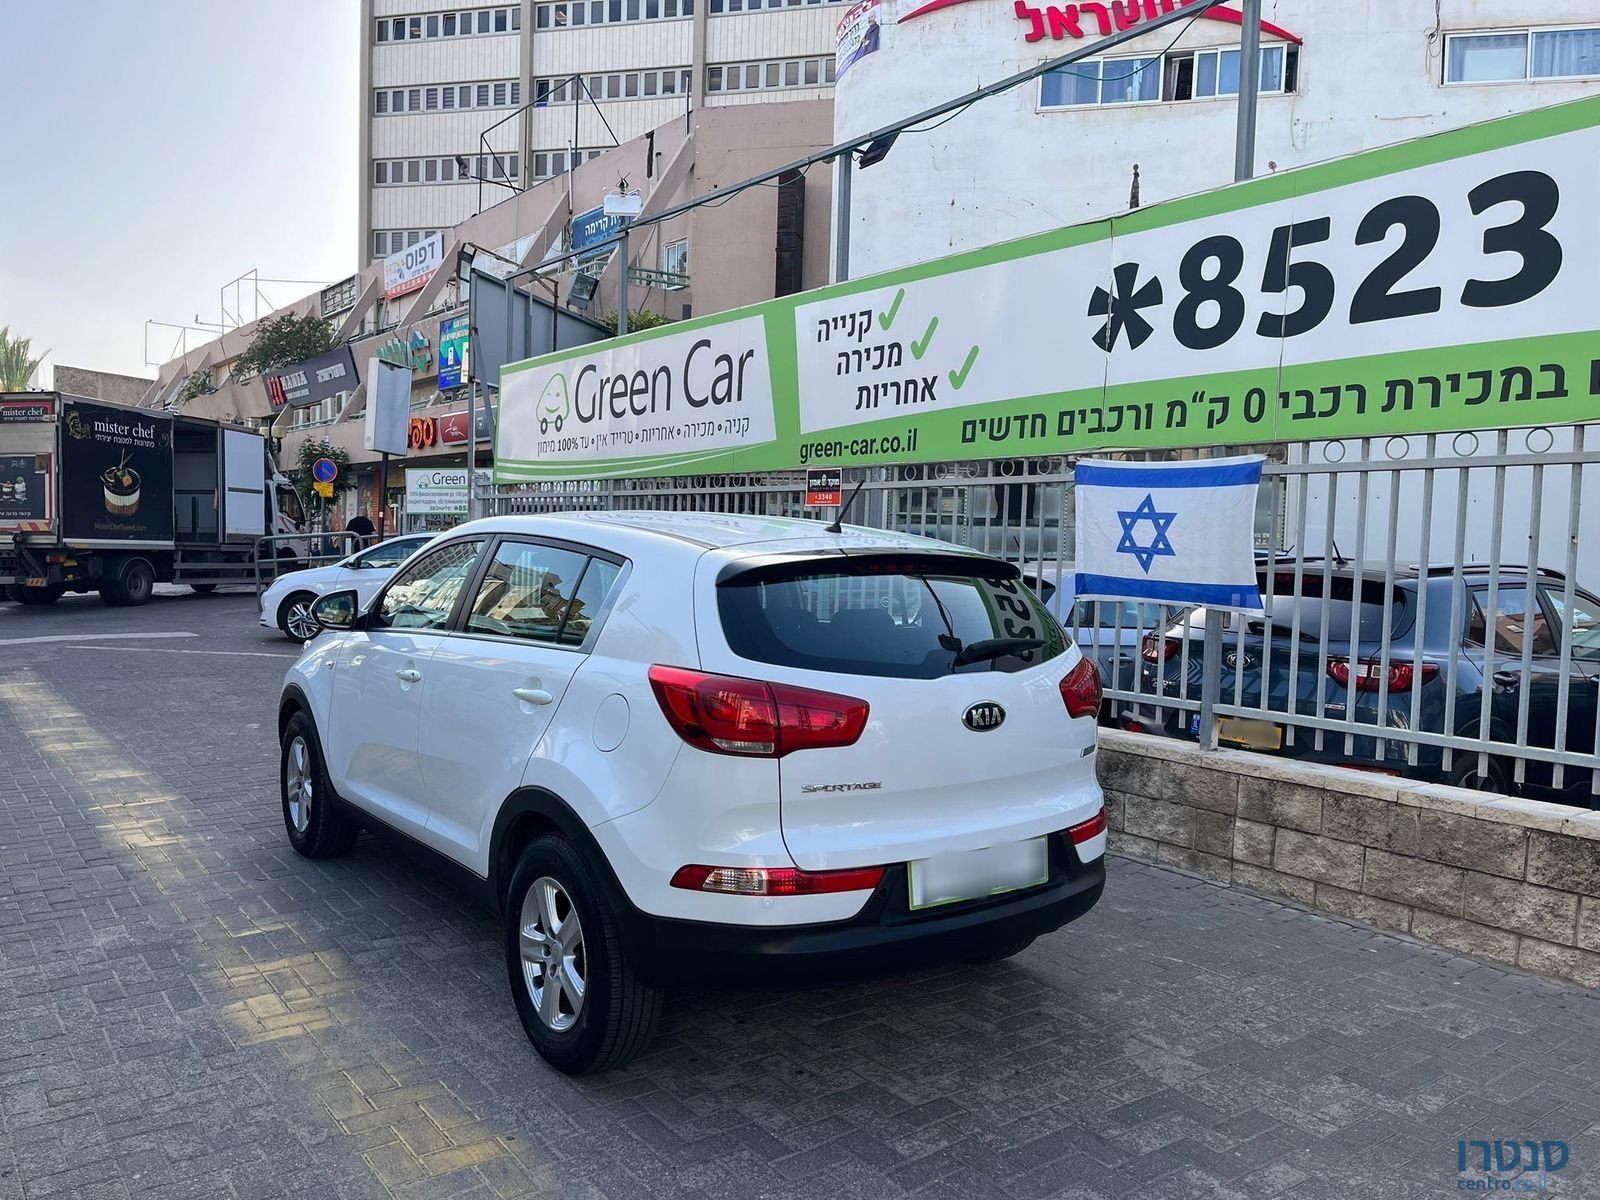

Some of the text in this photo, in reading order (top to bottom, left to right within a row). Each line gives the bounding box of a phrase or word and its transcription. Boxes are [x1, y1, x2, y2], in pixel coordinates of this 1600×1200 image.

[584, 216, 609, 237] קדימה
[405, 240, 437, 271] דפוס
[817, 309, 873, 343] קנייה
[836, 341, 903, 376] מכירה
[574, 339, 755, 424] Green Car
[855, 375, 939, 411] אחריות
[1380, 362, 1570, 413] במכירת
[2, 406, 44, 417] mister chef
[1056, 402, 1154, 436] ורכבים
[1243, 386, 1267, 425] 0
[1279, 383, 1368, 421] רכבי
[94, 417, 156, 439] mister chef
[537, 416, 750, 457] קניה מכירה אחריות טרייד אין עד 100% מימון
[960, 411, 1047, 444] חדשים
[800, 427, 918, 465] green-car.co.il
[432, 472, 466, 485] Green
[971, 706, 1002, 727] KIA
[800, 780, 882, 794] SPORTAGE
